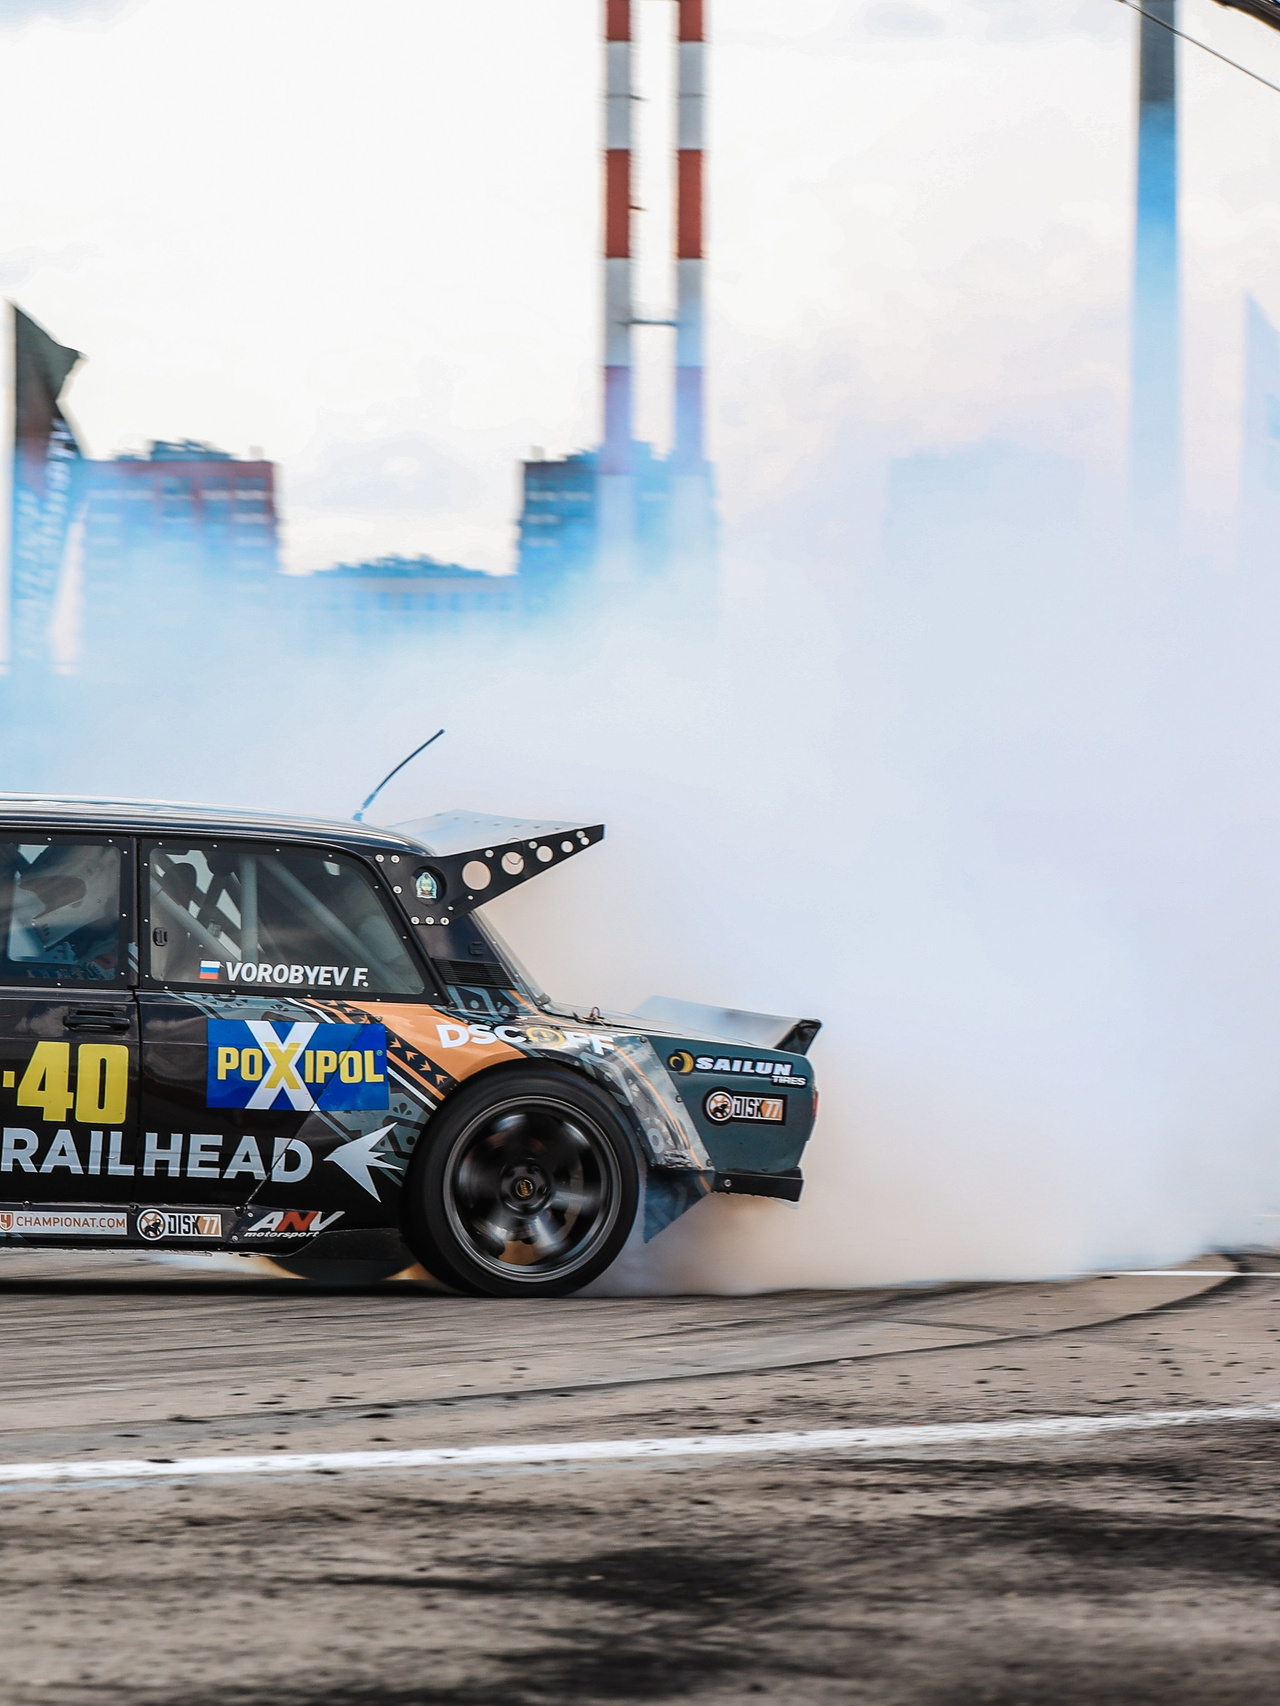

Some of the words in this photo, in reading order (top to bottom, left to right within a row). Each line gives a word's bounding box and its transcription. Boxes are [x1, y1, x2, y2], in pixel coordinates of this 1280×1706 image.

[225, 961, 349, 986] VOROBYEV
[352, 967, 370, 988] F.
[216, 1020, 385, 1111] POXIPOL
[695, 1057, 793, 1076] SAILUN
[771, 1075, 806, 1086] TIRES
[16, 1216, 126, 1229] CHAMPIONAT.COM
[244, 1231, 320, 1239] motorsport
